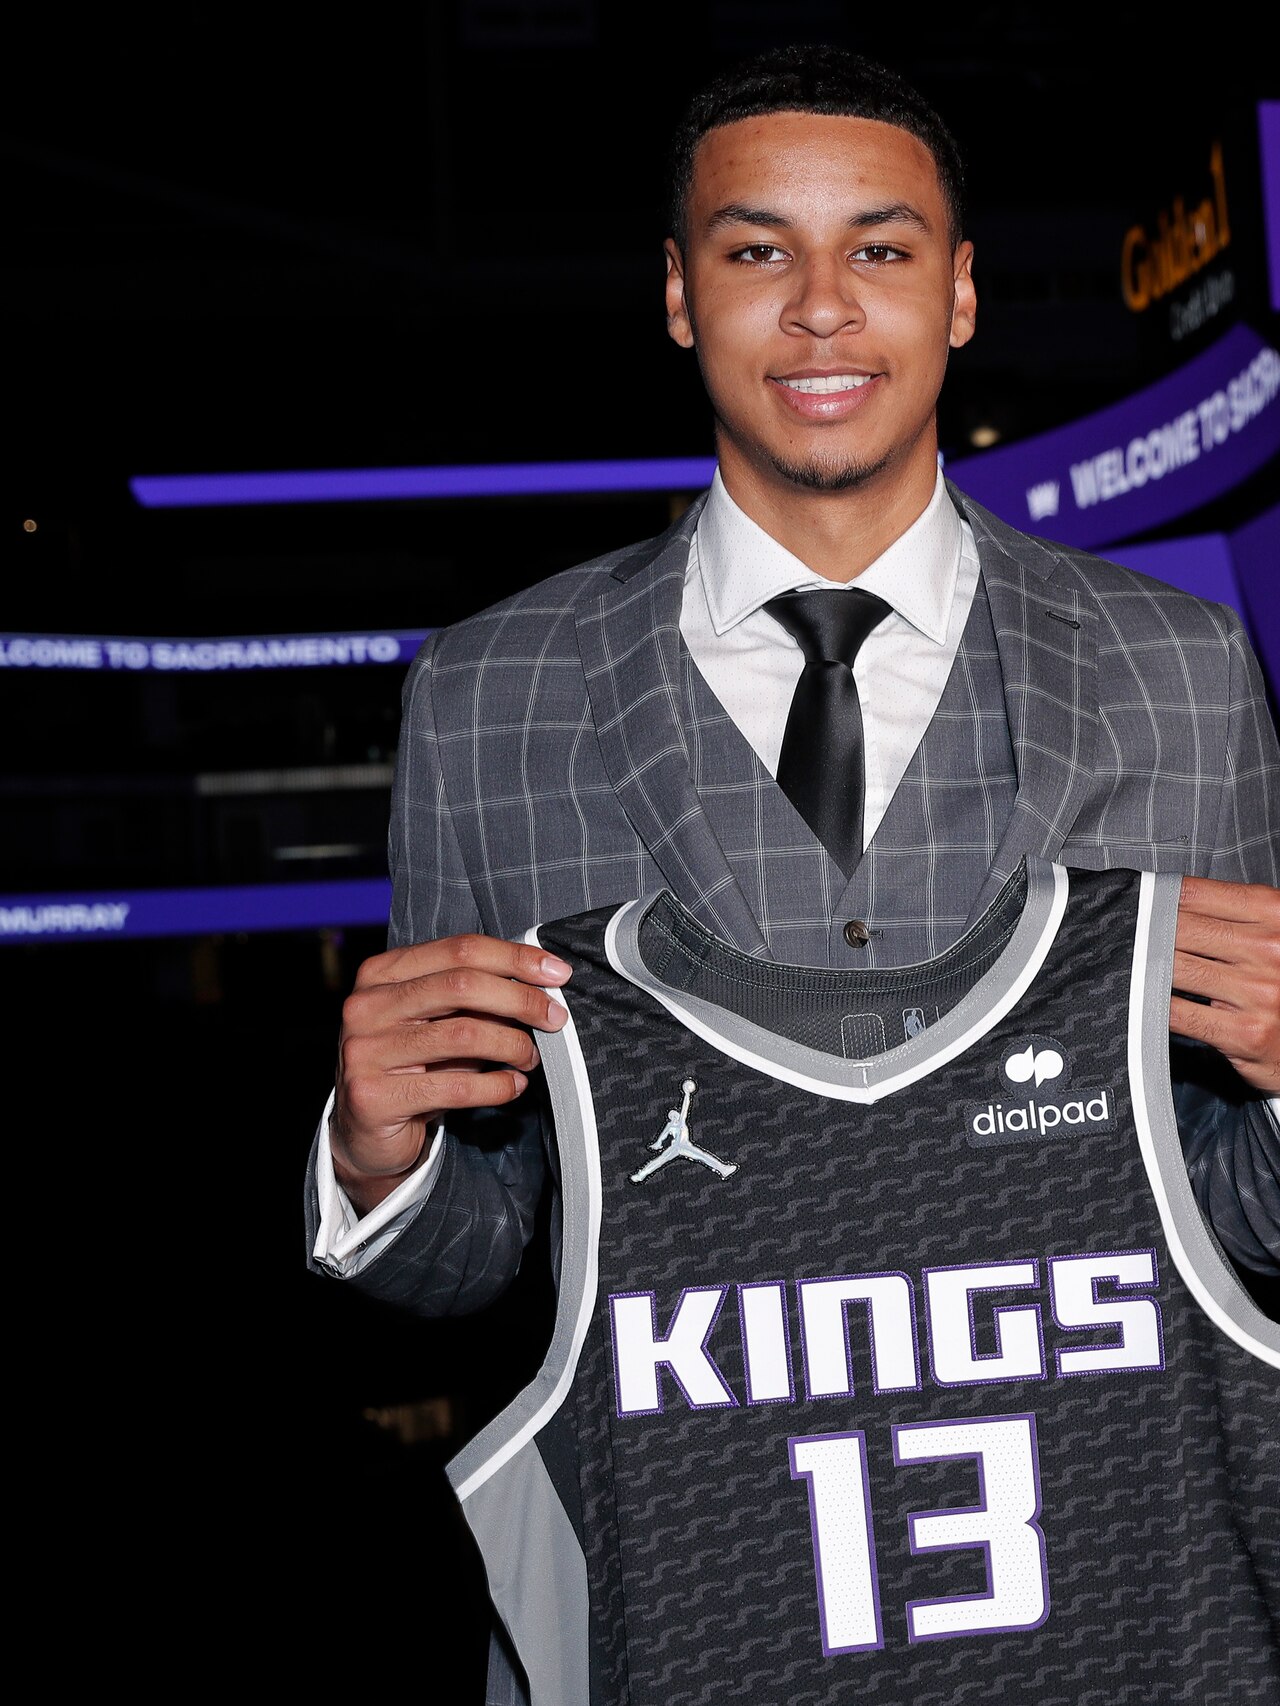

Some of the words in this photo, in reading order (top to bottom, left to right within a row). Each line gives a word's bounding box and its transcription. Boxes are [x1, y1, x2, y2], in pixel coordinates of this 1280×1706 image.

[1069, 409, 1201, 509] WELCOME
[1197, 390, 1231, 451] TO
[104, 641, 150, 669] TO
[151, 636, 400, 669] SACRAMENTO
[972, 1090, 1110, 1136] dialpad
[609, 1247, 1166, 1418] KINGS
[788, 1412, 1050, 1657] 13
